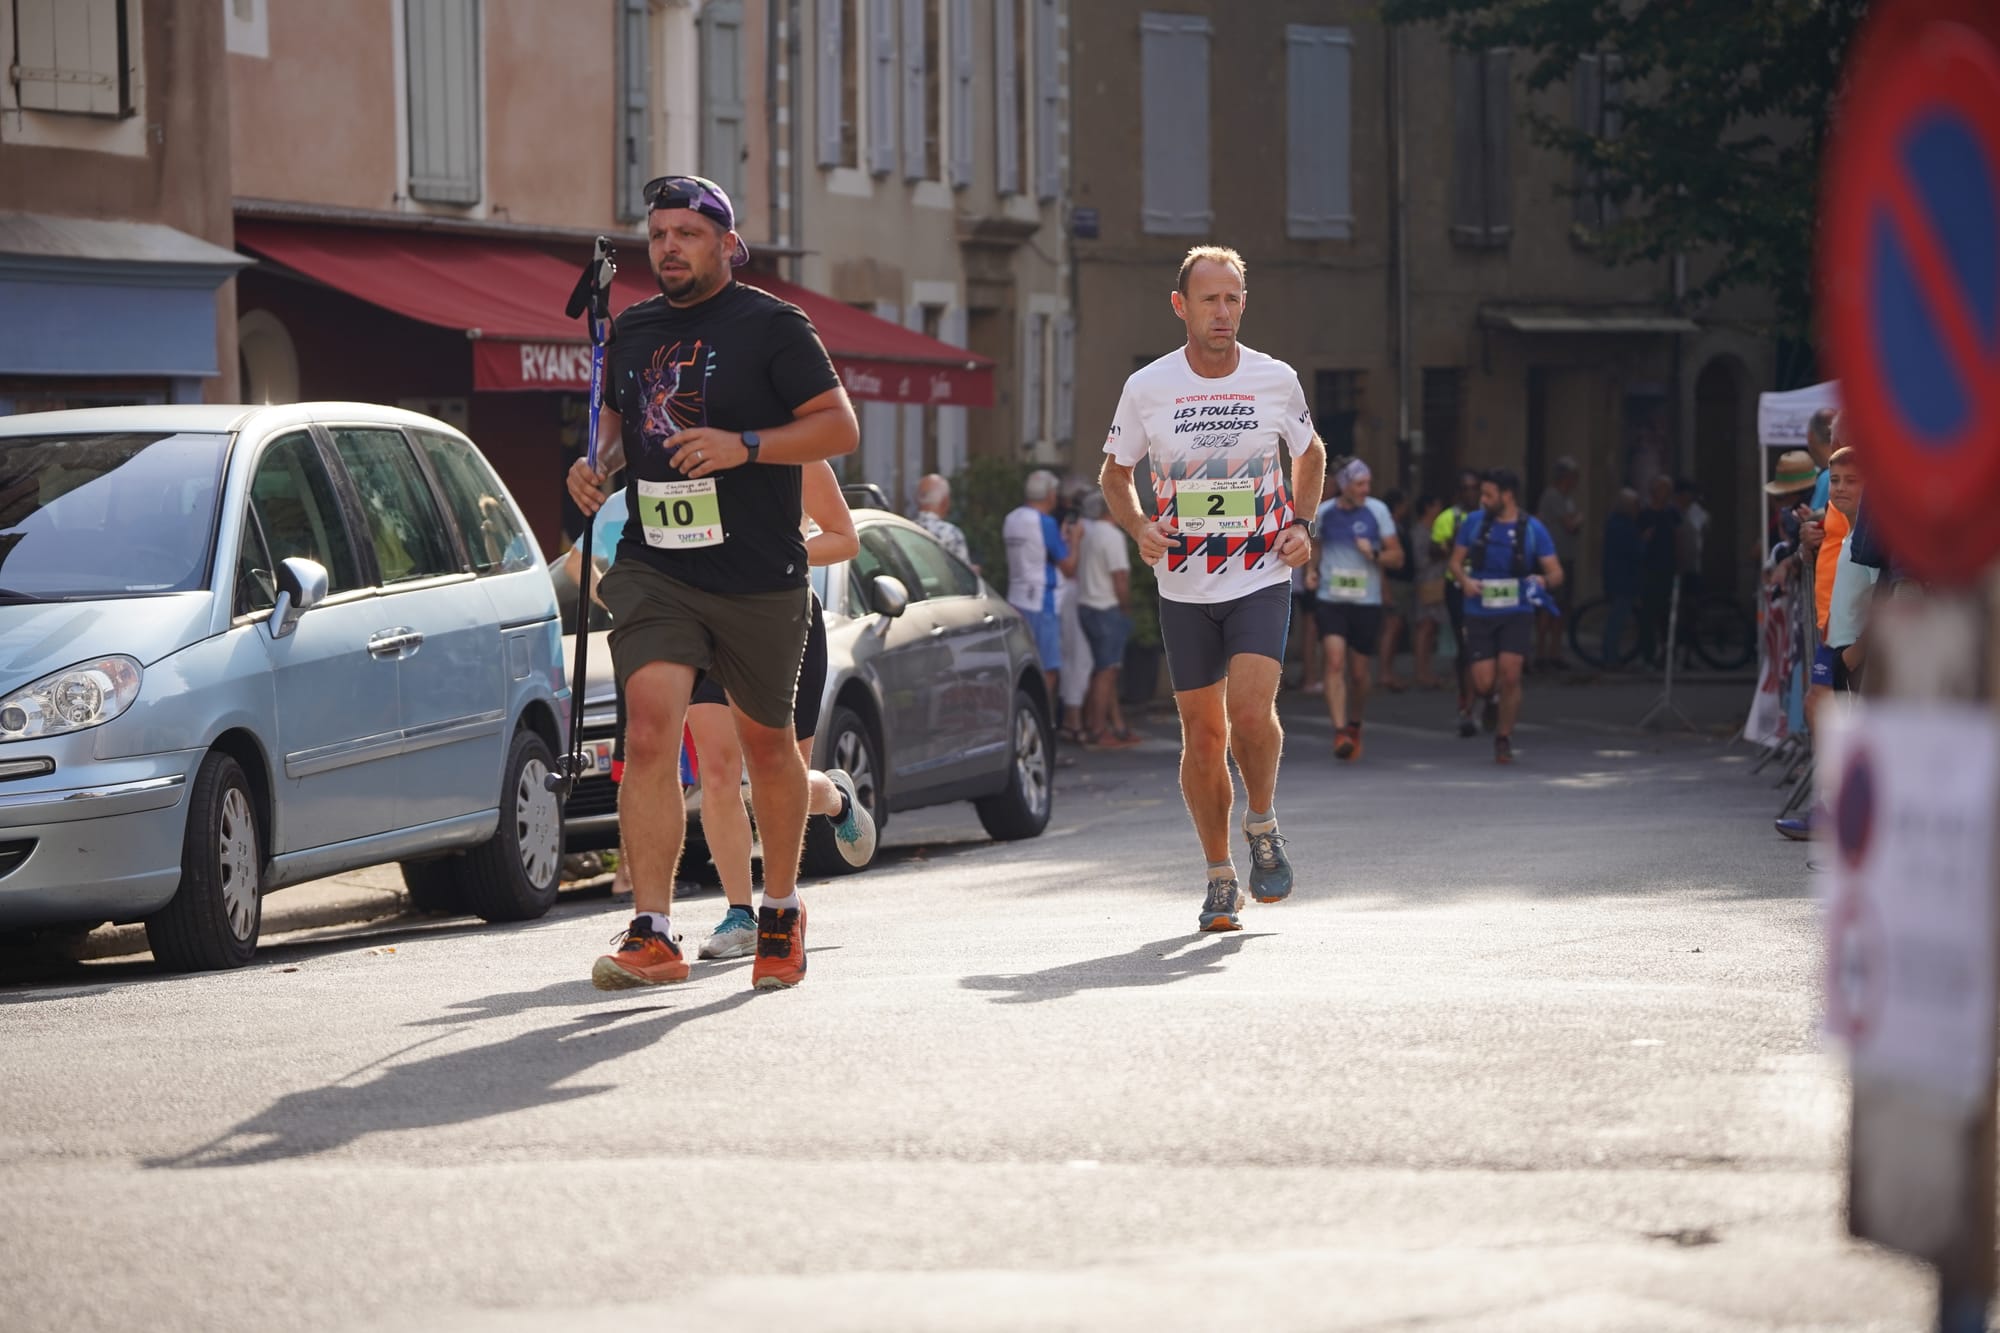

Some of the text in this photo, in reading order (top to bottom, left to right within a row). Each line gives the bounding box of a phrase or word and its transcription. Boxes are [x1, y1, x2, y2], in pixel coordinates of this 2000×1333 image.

[520, 344, 591, 382] RYAN'S
[1174, 402, 1255, 420] LES FOULÉES
[1191, 432, 1242, 449] 2025
[655, 499, 694, 527] 10
[1207, 494, 1225, 516] 2
